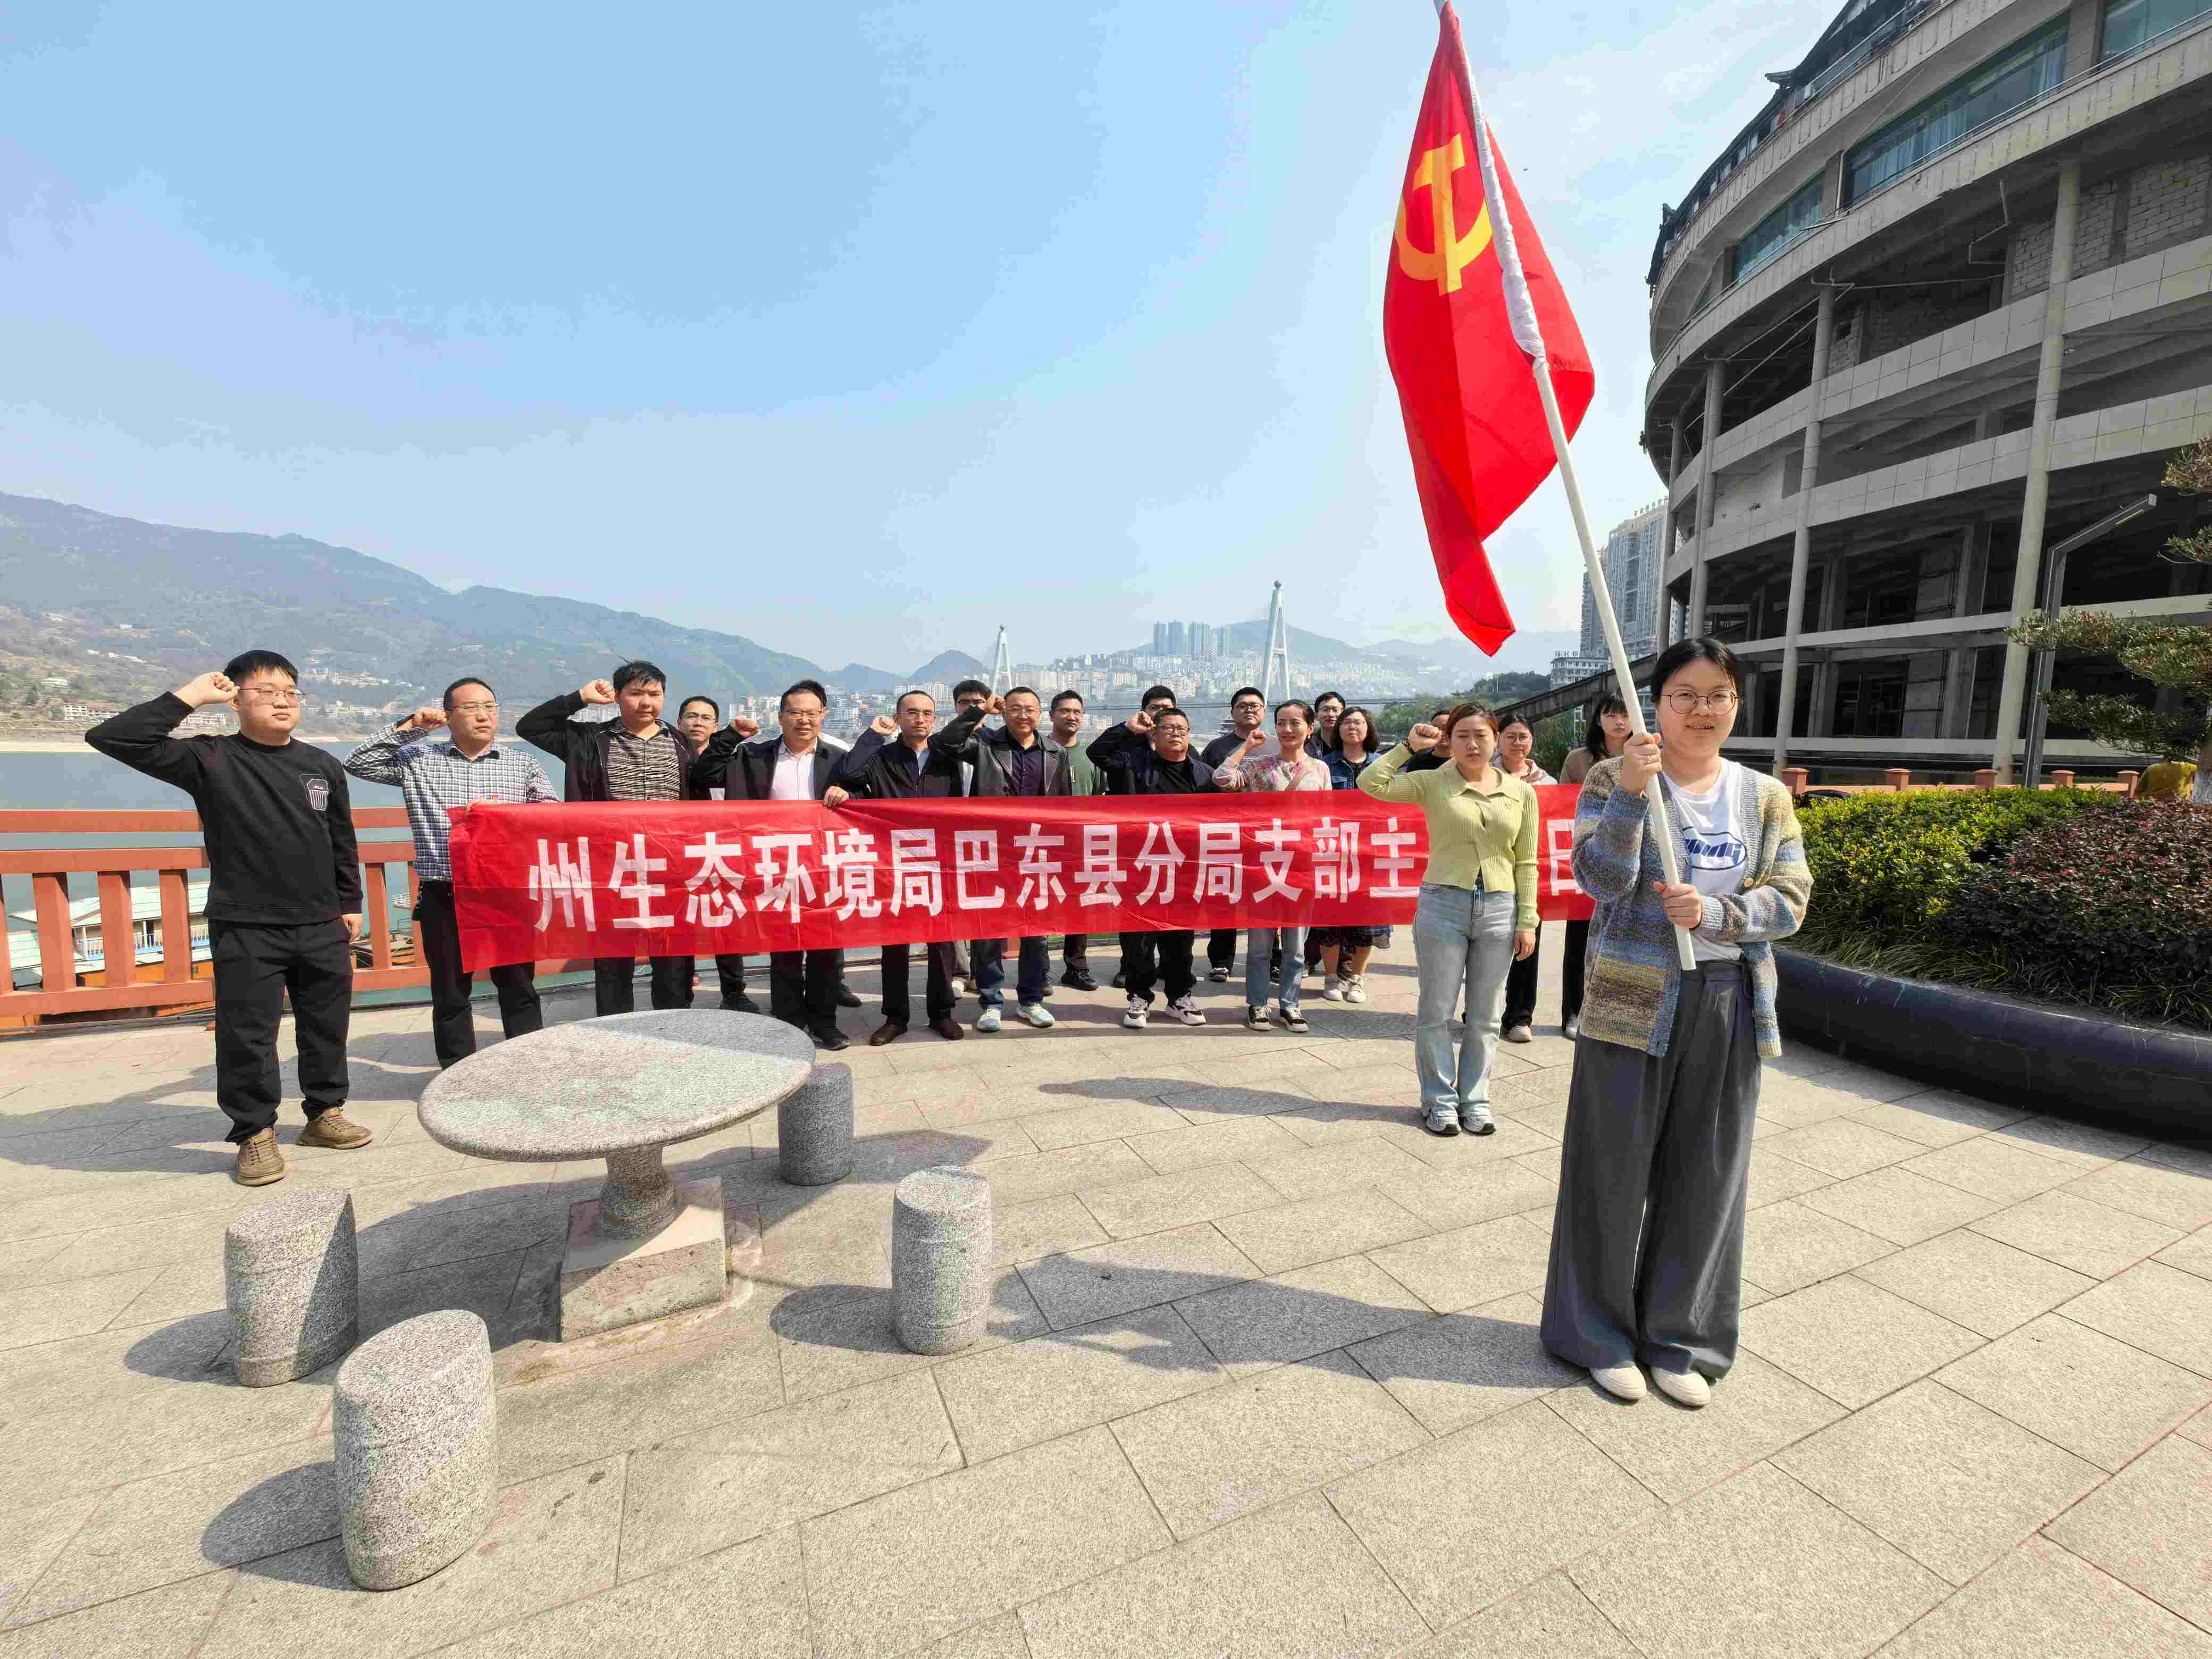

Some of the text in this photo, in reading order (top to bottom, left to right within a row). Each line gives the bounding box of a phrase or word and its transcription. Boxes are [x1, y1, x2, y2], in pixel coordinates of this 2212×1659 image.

[529, 816, 1583, 932] 州生态环境局巴东县分局支部主日
